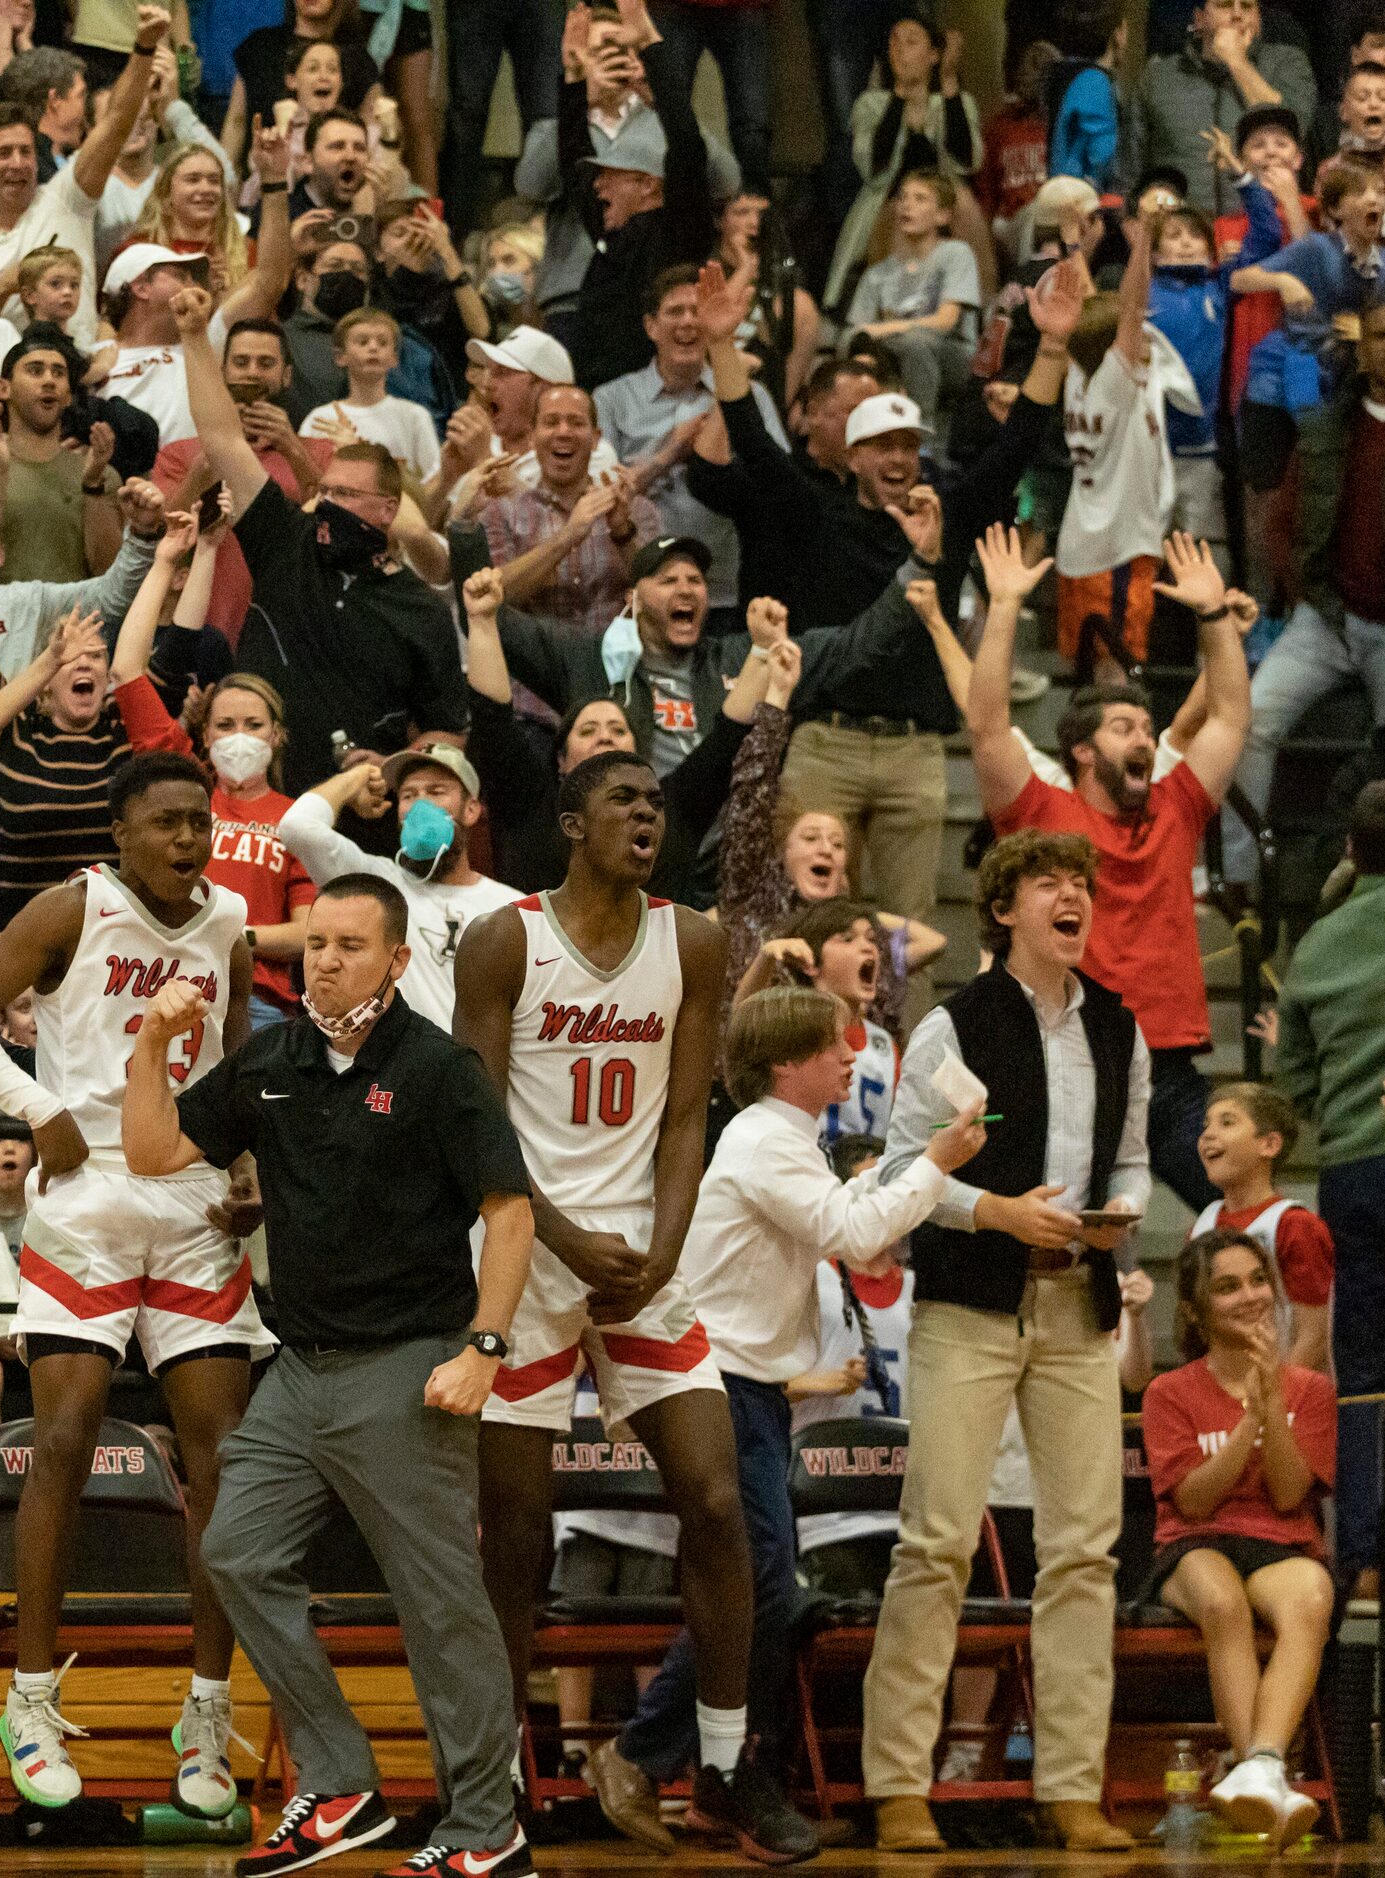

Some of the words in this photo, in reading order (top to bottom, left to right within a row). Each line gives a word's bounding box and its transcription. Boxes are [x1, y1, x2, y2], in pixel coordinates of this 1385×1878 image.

[212, 829, 286, 874] CATS
[538, 1001, 665, 1044] Wildcats
[365, 1083, 393, 1114] LH
[571, 1057, 636, 1126] 10
